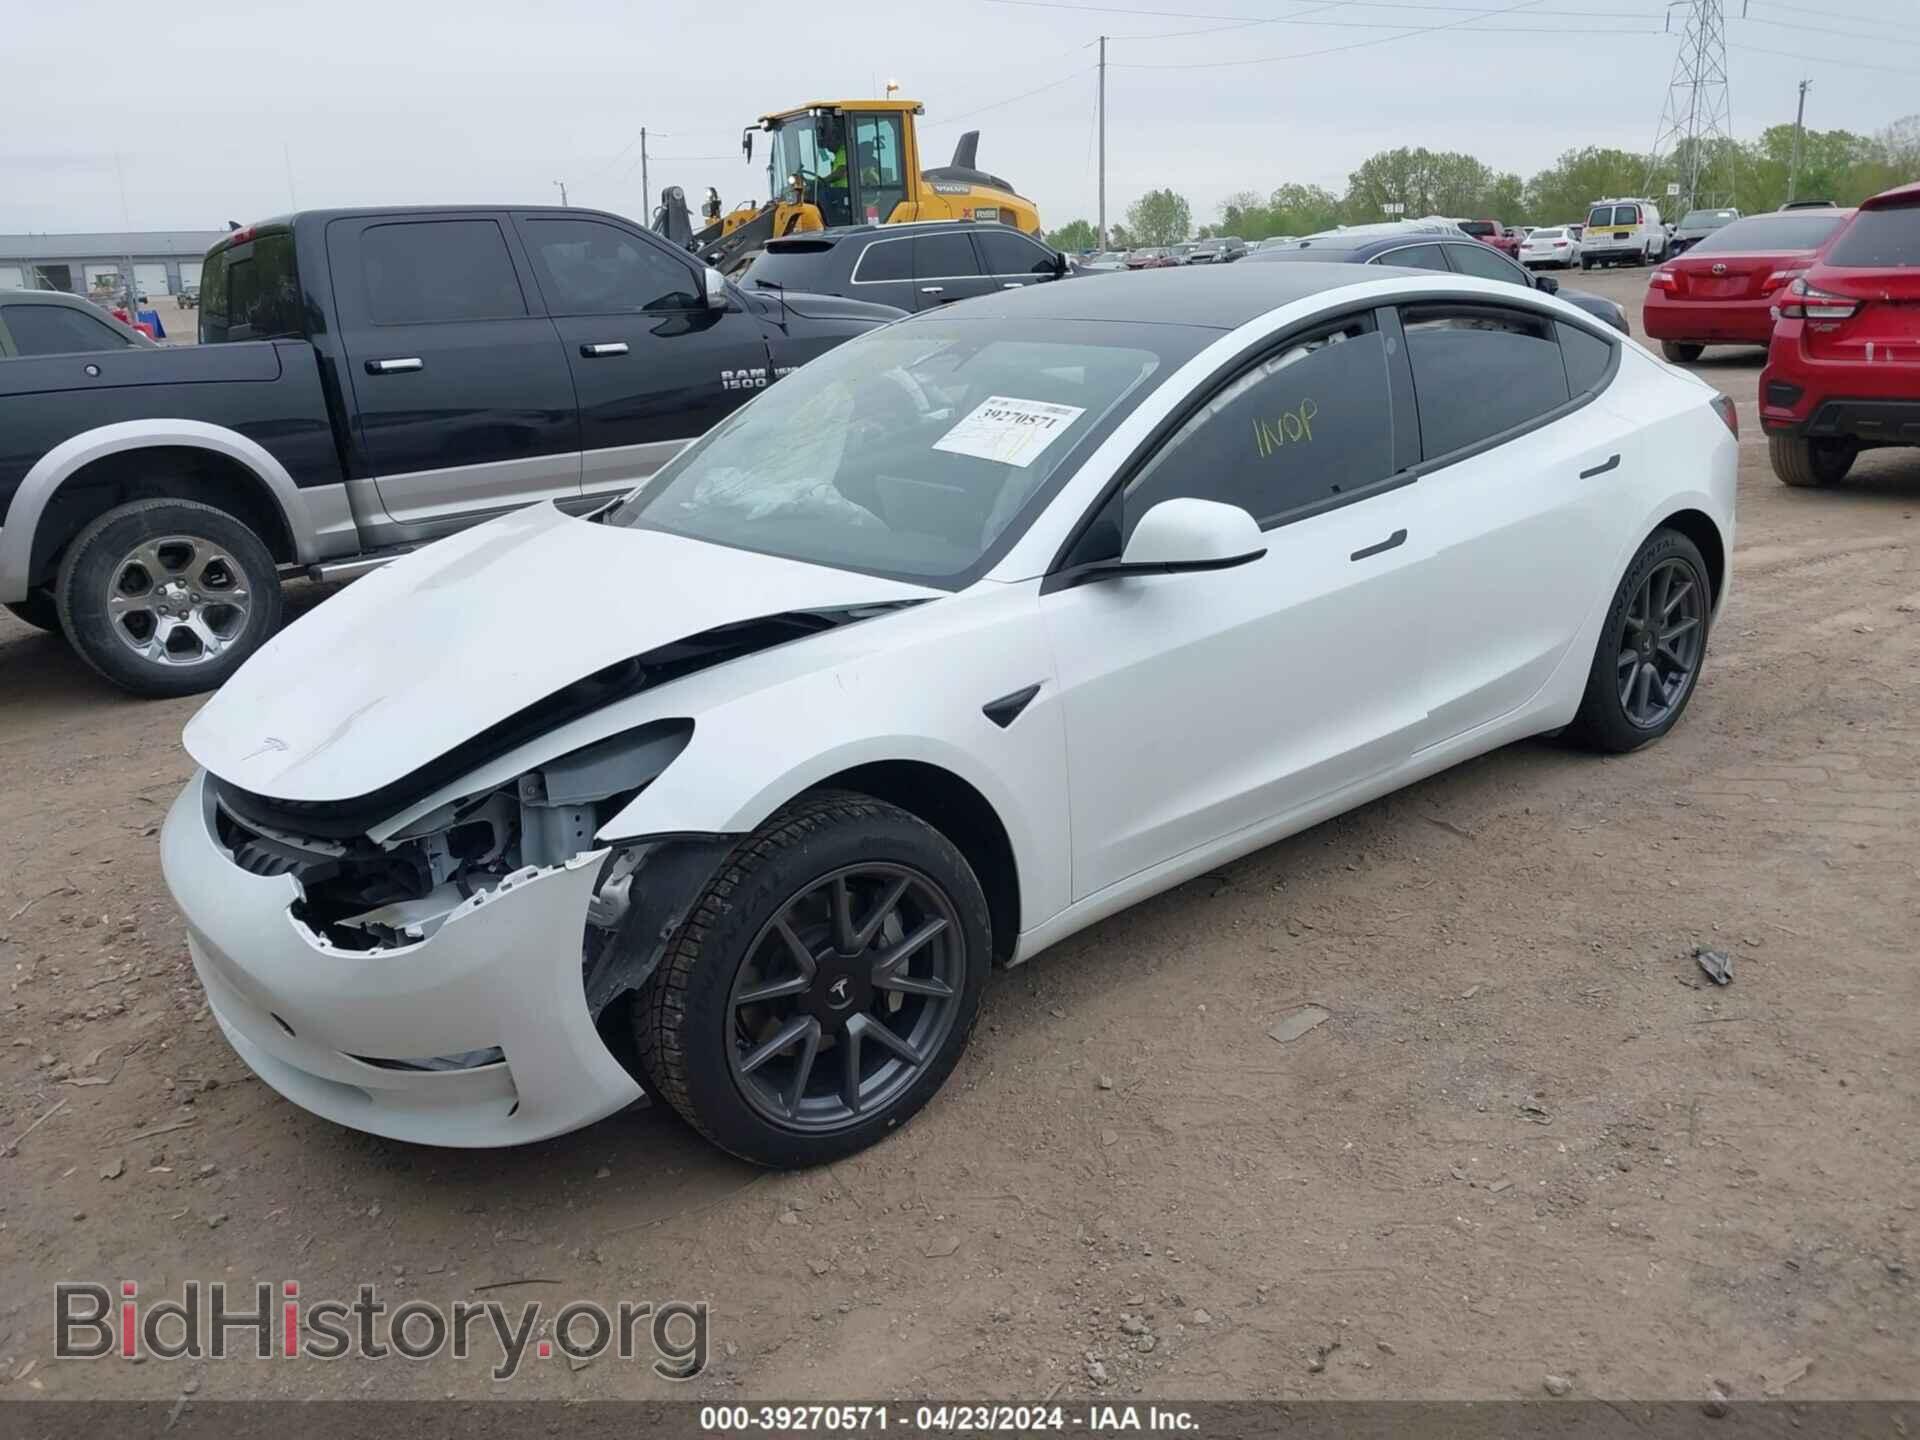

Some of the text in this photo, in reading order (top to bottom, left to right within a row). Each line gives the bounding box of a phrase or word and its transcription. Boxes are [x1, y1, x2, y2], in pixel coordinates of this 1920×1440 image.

[720, 368, 766, 380] RAM
[722, 378, 767, 390] 1500
[977, 408, 1057, 429] 39270571
[1252, 398, 1318, 457] INOP
